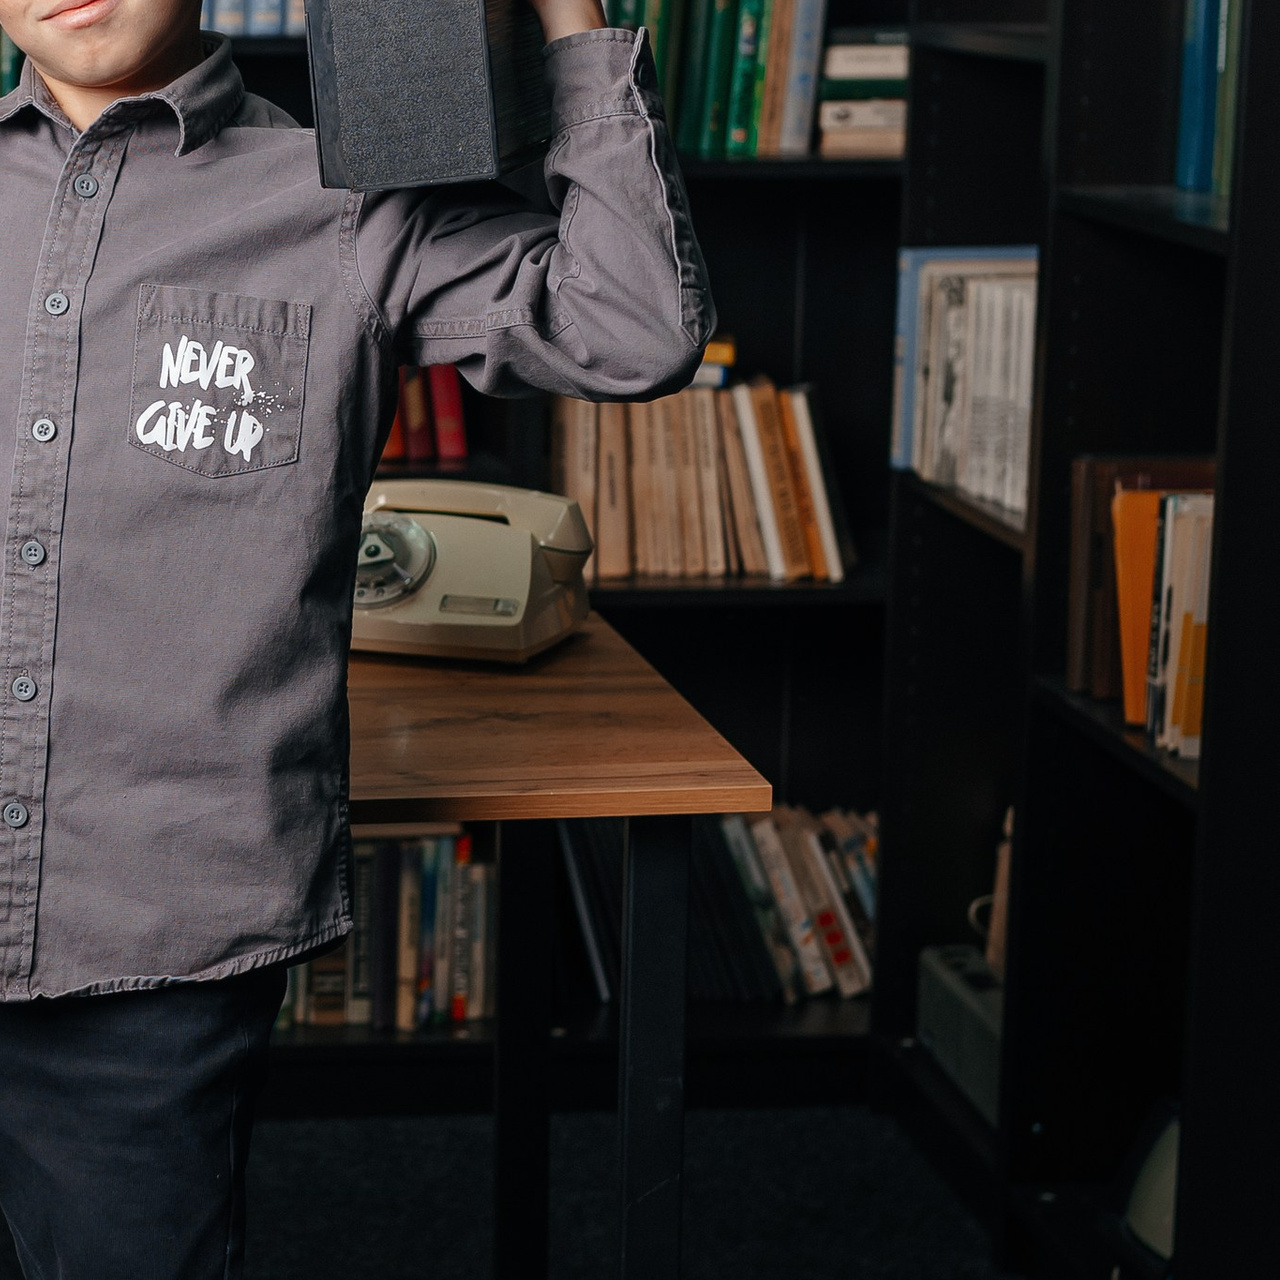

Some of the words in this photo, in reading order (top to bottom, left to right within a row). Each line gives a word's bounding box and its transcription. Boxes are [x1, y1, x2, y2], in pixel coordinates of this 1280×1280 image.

[159, 334, 256, 407] NEVER
[135, 399, 217, 453] GIVE
[223, 409, 265, 462] UP
